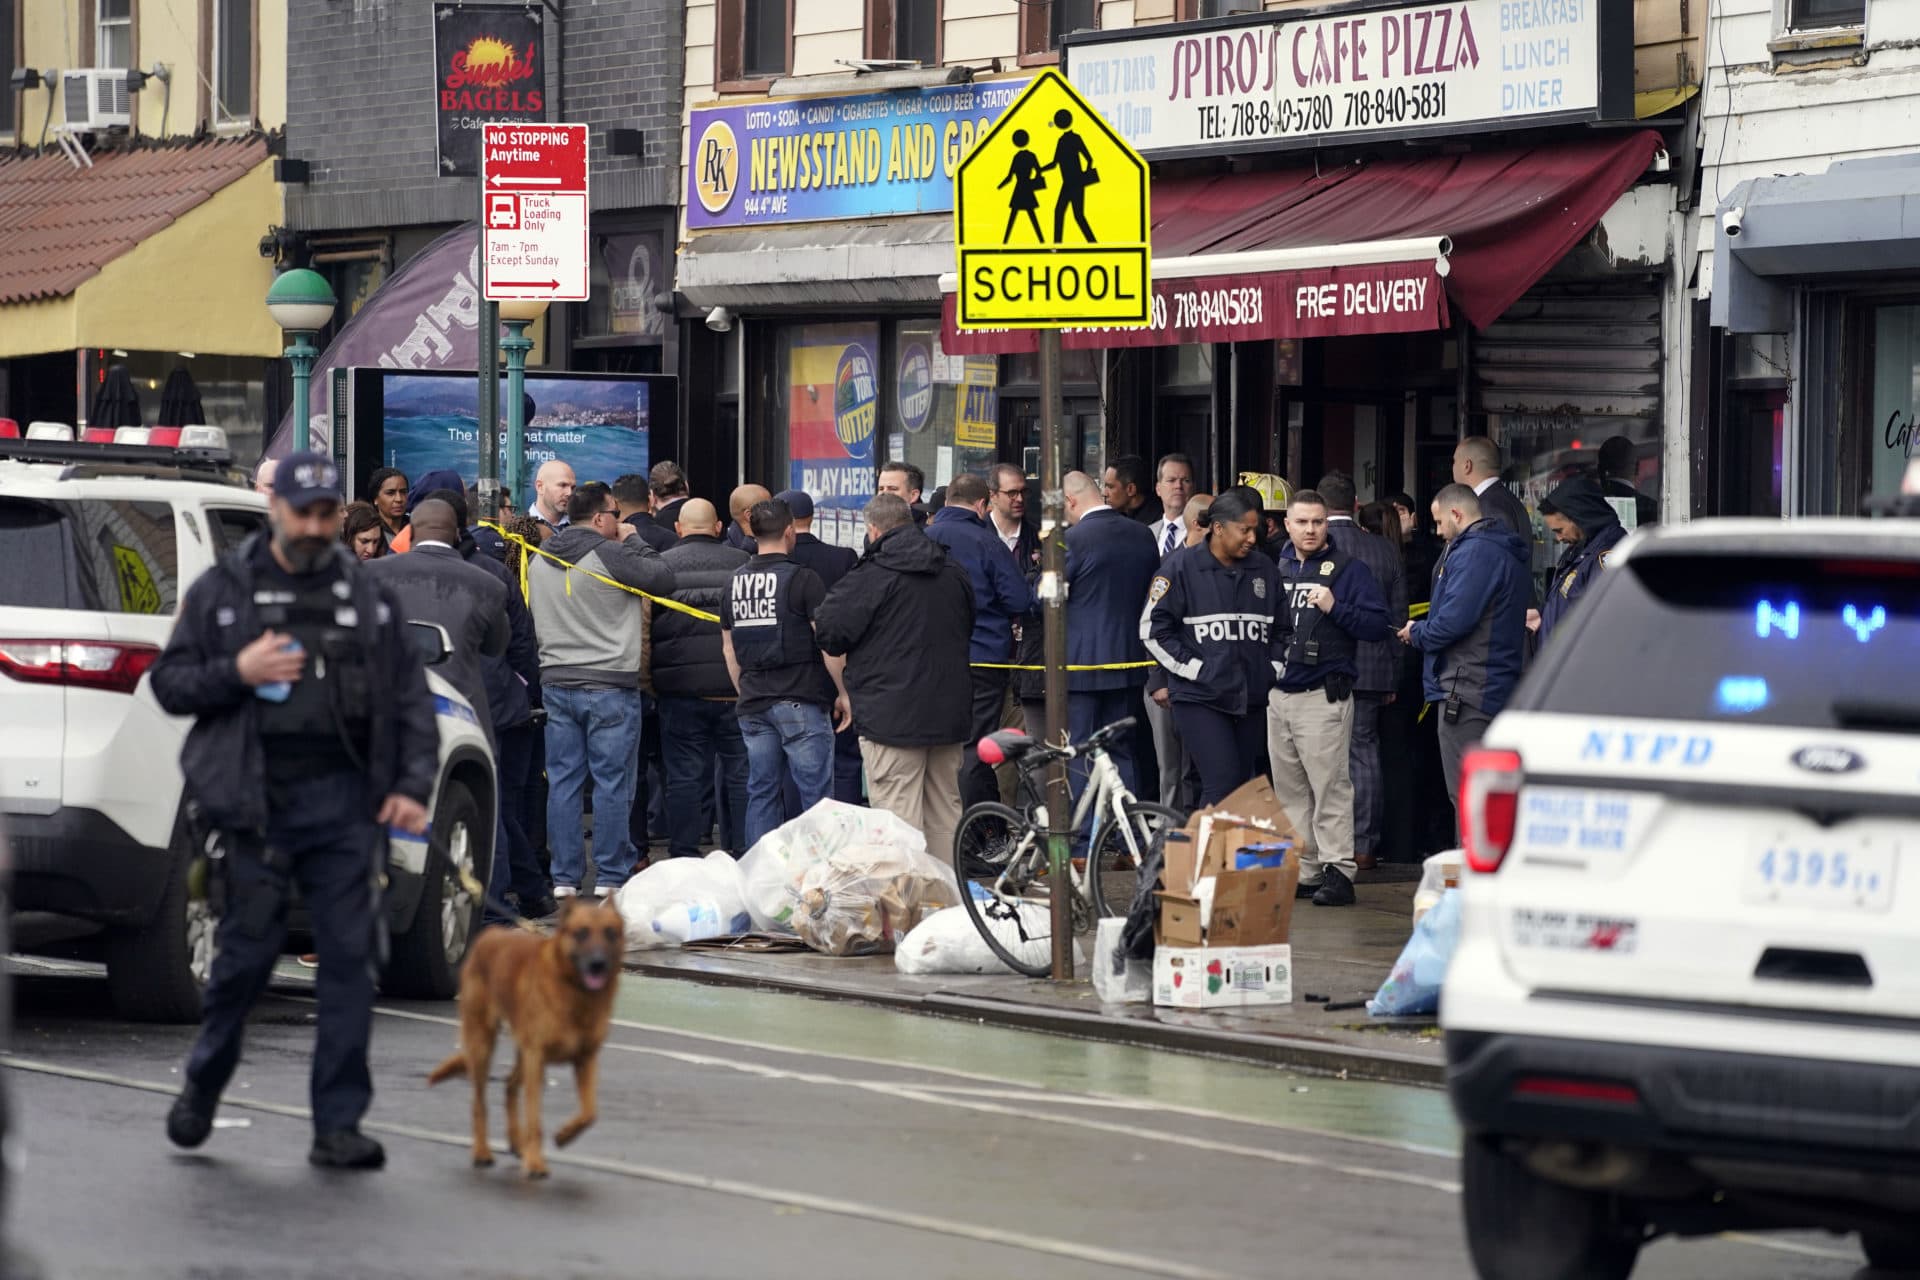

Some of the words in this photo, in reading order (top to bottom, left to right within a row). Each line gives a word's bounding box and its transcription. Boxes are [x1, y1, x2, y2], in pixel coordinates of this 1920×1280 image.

[445, 41, 535, 88] Sunset
[1168, 29, 1281, 101] SPIRO'S
[1292, 19, 1369, 88] CAFE
[1382, 5, 1480, 79] PIZZA
[1502, 38, 1570, 72] LUNCH
[1078, 60, 1109, 96] OPEN
[1112, 59, 1120, 94] 7
[1123, 55, 1155, 92] DAYS
[441, 90, 543, 112] BAGELS
[1502, 78, 1563, 111] DINER
[746, 111, 771, 130] LOTTO
[778, 108, 800, 127] SODA
[807, 105, 835, 125] CANDY
[842, 100, 888, 121] CIGARETTES
[896, 97, 922, 116] CIGAR
[929, 95, 951, 113] COLD
[954, 92, 974, 111] BEER
[1198, 105, 1226, 140] TEL:
[1343, 81, 1446, 127] 718-840-5831
[490, 132, 507, 145] NO
[510, 131, 569, 146] STOPPING
[490, 148, 540, 163] Anytime
[750, 127, 881, 192] NEWSSTAND
[887, 122, 936, 182] AND
[524, 198, 550, 207] Truck
[524, 210, 561, 220] Loading
[744, 198, 759, 216] 944
[771, 195, 787, 214] AVE
[524, 220, 545, 232] Only
[490, 242, 509, 251] 7am
[519, 242, 539, 253] 7pm
[490, 255, 522, 267] Except
[525, 255, 559, 267] Sunday
[973, 265, 1135, 301] SCHOOL
[1296, 283, 1338, 319] FREE
[1343, 277, 1428, 316] DELIVERY
[447, 428, 473, 441] The
[545, 431, 587, 443] matter
[803, 467, 840, 496] PLAY
[842, 466, 875, 496] HERE
[731, 572, 777, 600] NYPD
[731, 598, 777, 620] POLICE
[1193, 620, 1269, 644] POLICE
[1581, 729, 1714, 766] NYPD
[1760, 849, 1850, 887] 4395
